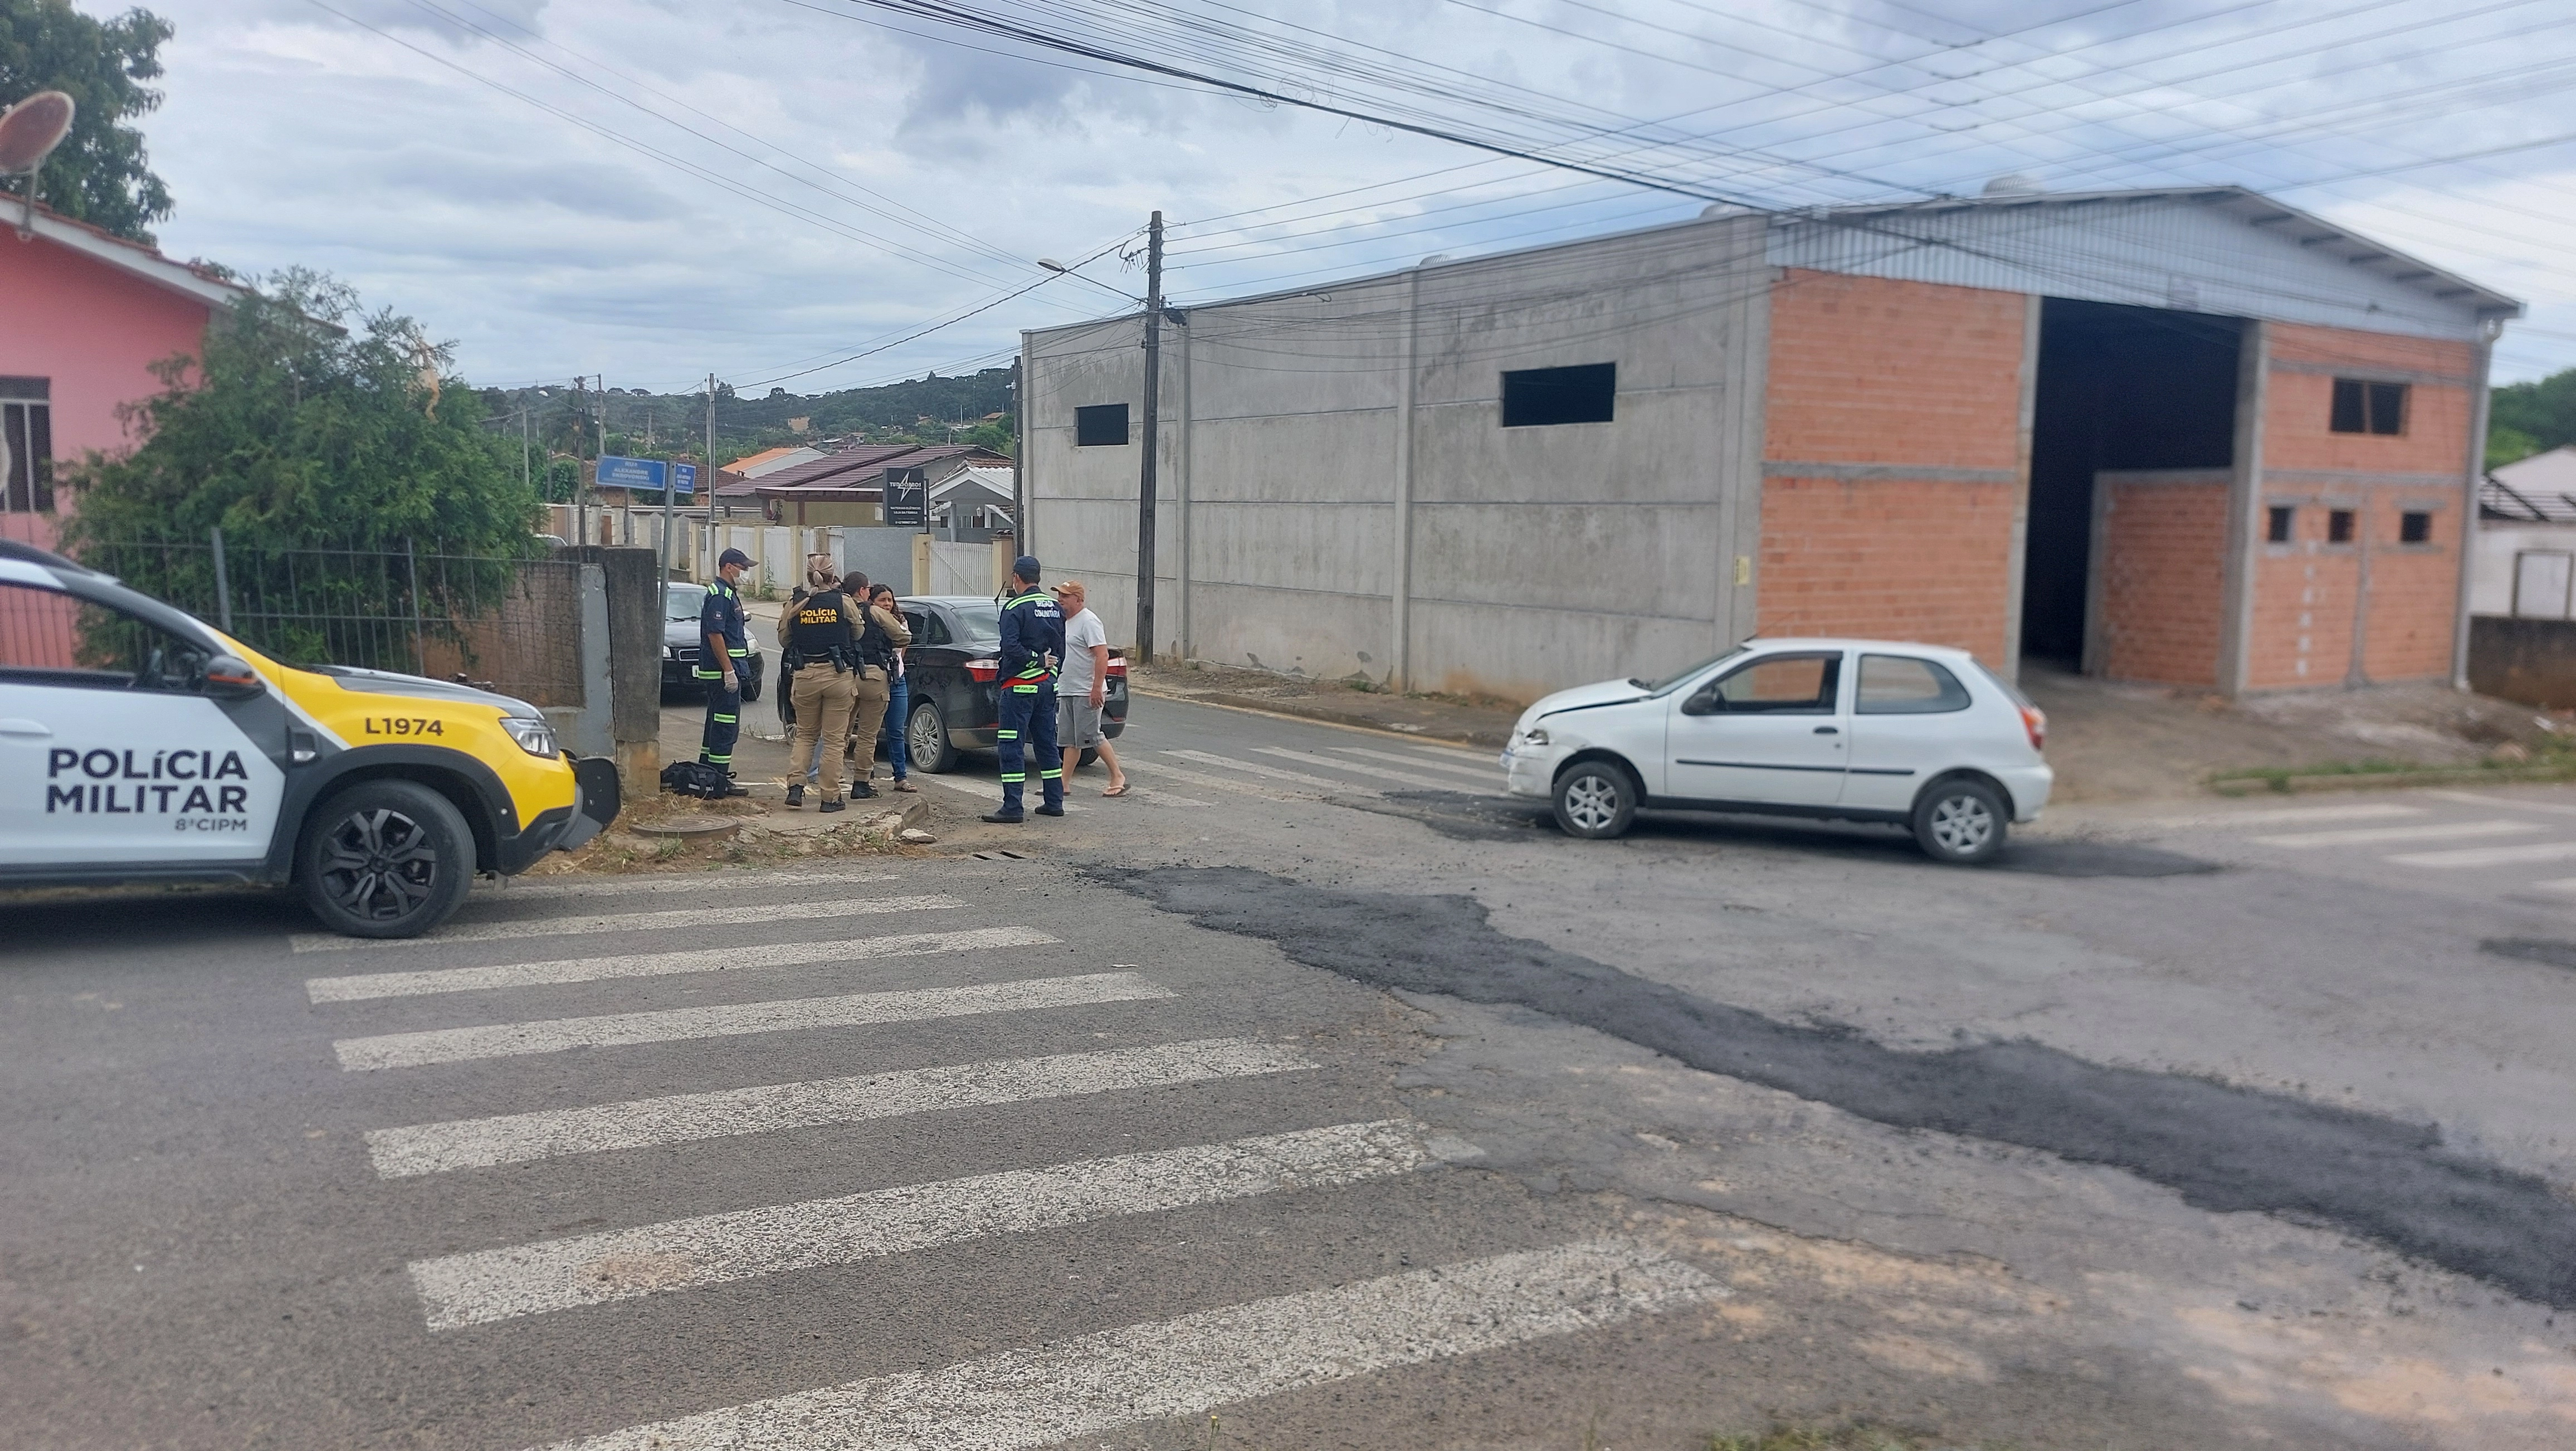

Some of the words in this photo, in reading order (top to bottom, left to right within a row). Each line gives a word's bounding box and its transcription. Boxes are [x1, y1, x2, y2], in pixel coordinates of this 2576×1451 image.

[800, 607, 837, 617] POLÍCIA
[801, 616, 837, 624] MILITAR
[365, 717, 444, 736] L1974
[46, 784, 249, 814] MILITAR
